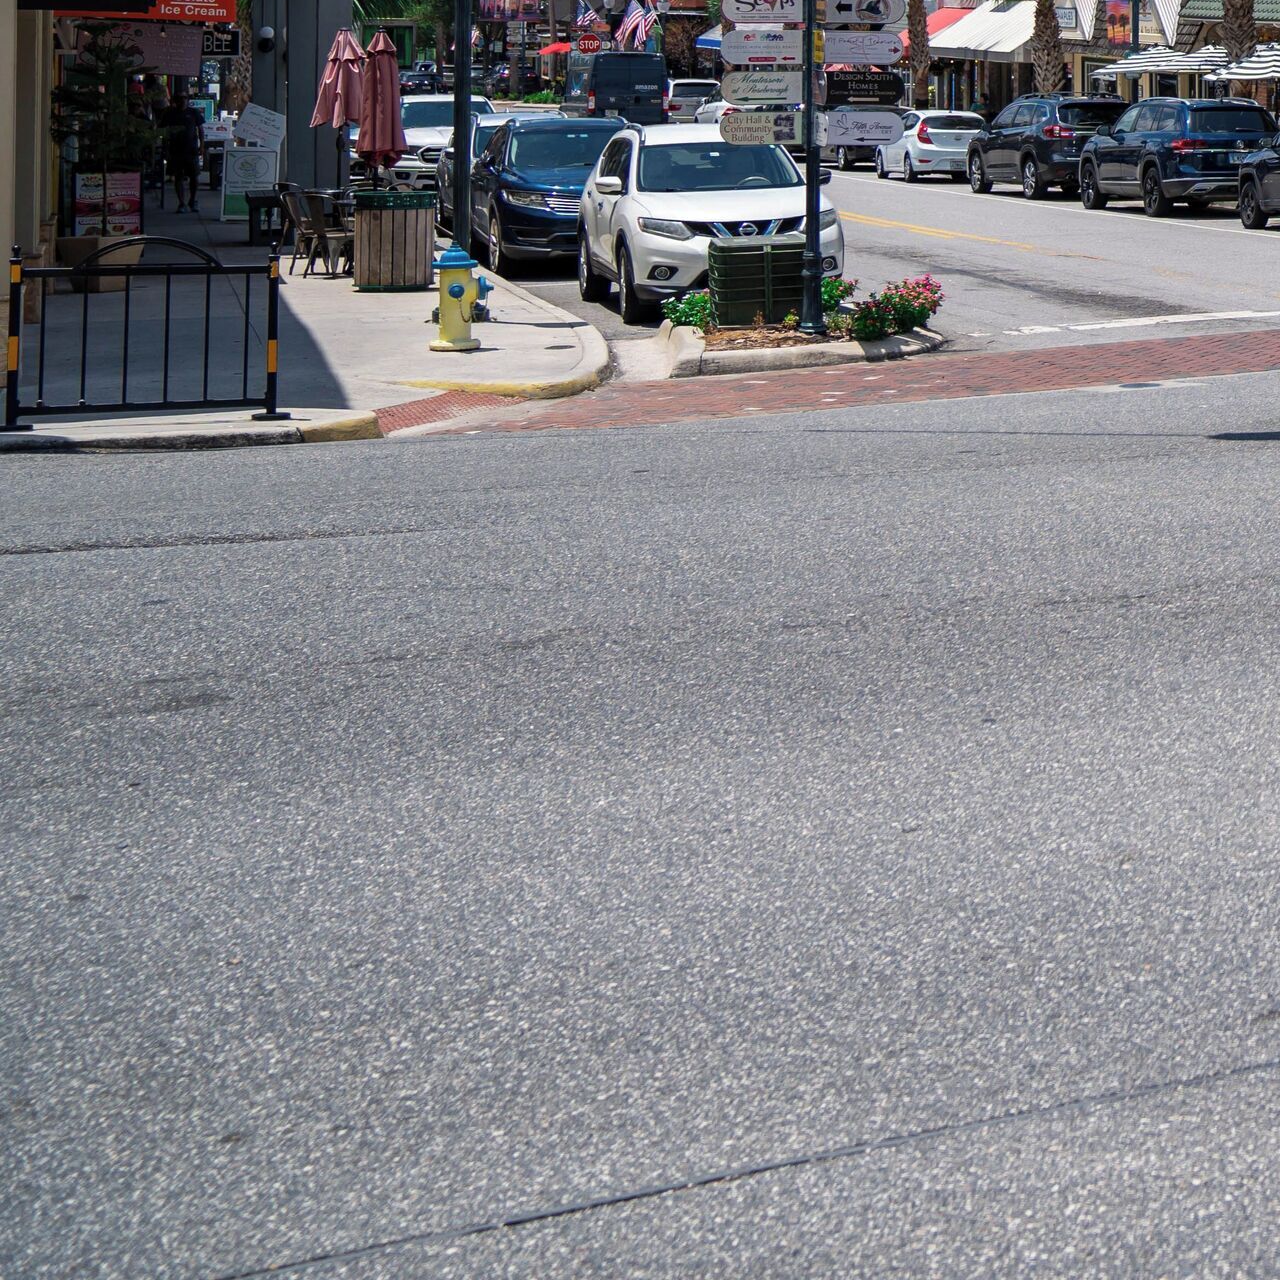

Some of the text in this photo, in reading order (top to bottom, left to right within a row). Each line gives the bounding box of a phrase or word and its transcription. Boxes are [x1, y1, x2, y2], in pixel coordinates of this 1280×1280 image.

[161, 4, 227, 17] Ice Cream
[203, 35, 231, 52] BEE
[579, 40, 600, 49] STOP
[834, 72, 894, 81] DESIGN SOUTH
[848, 81, 879, 90] HOMES
[727, 115, 771, 125] City Hall &
[724, 125, 773, 136] Community
[731, 134, 765, 143] Building
